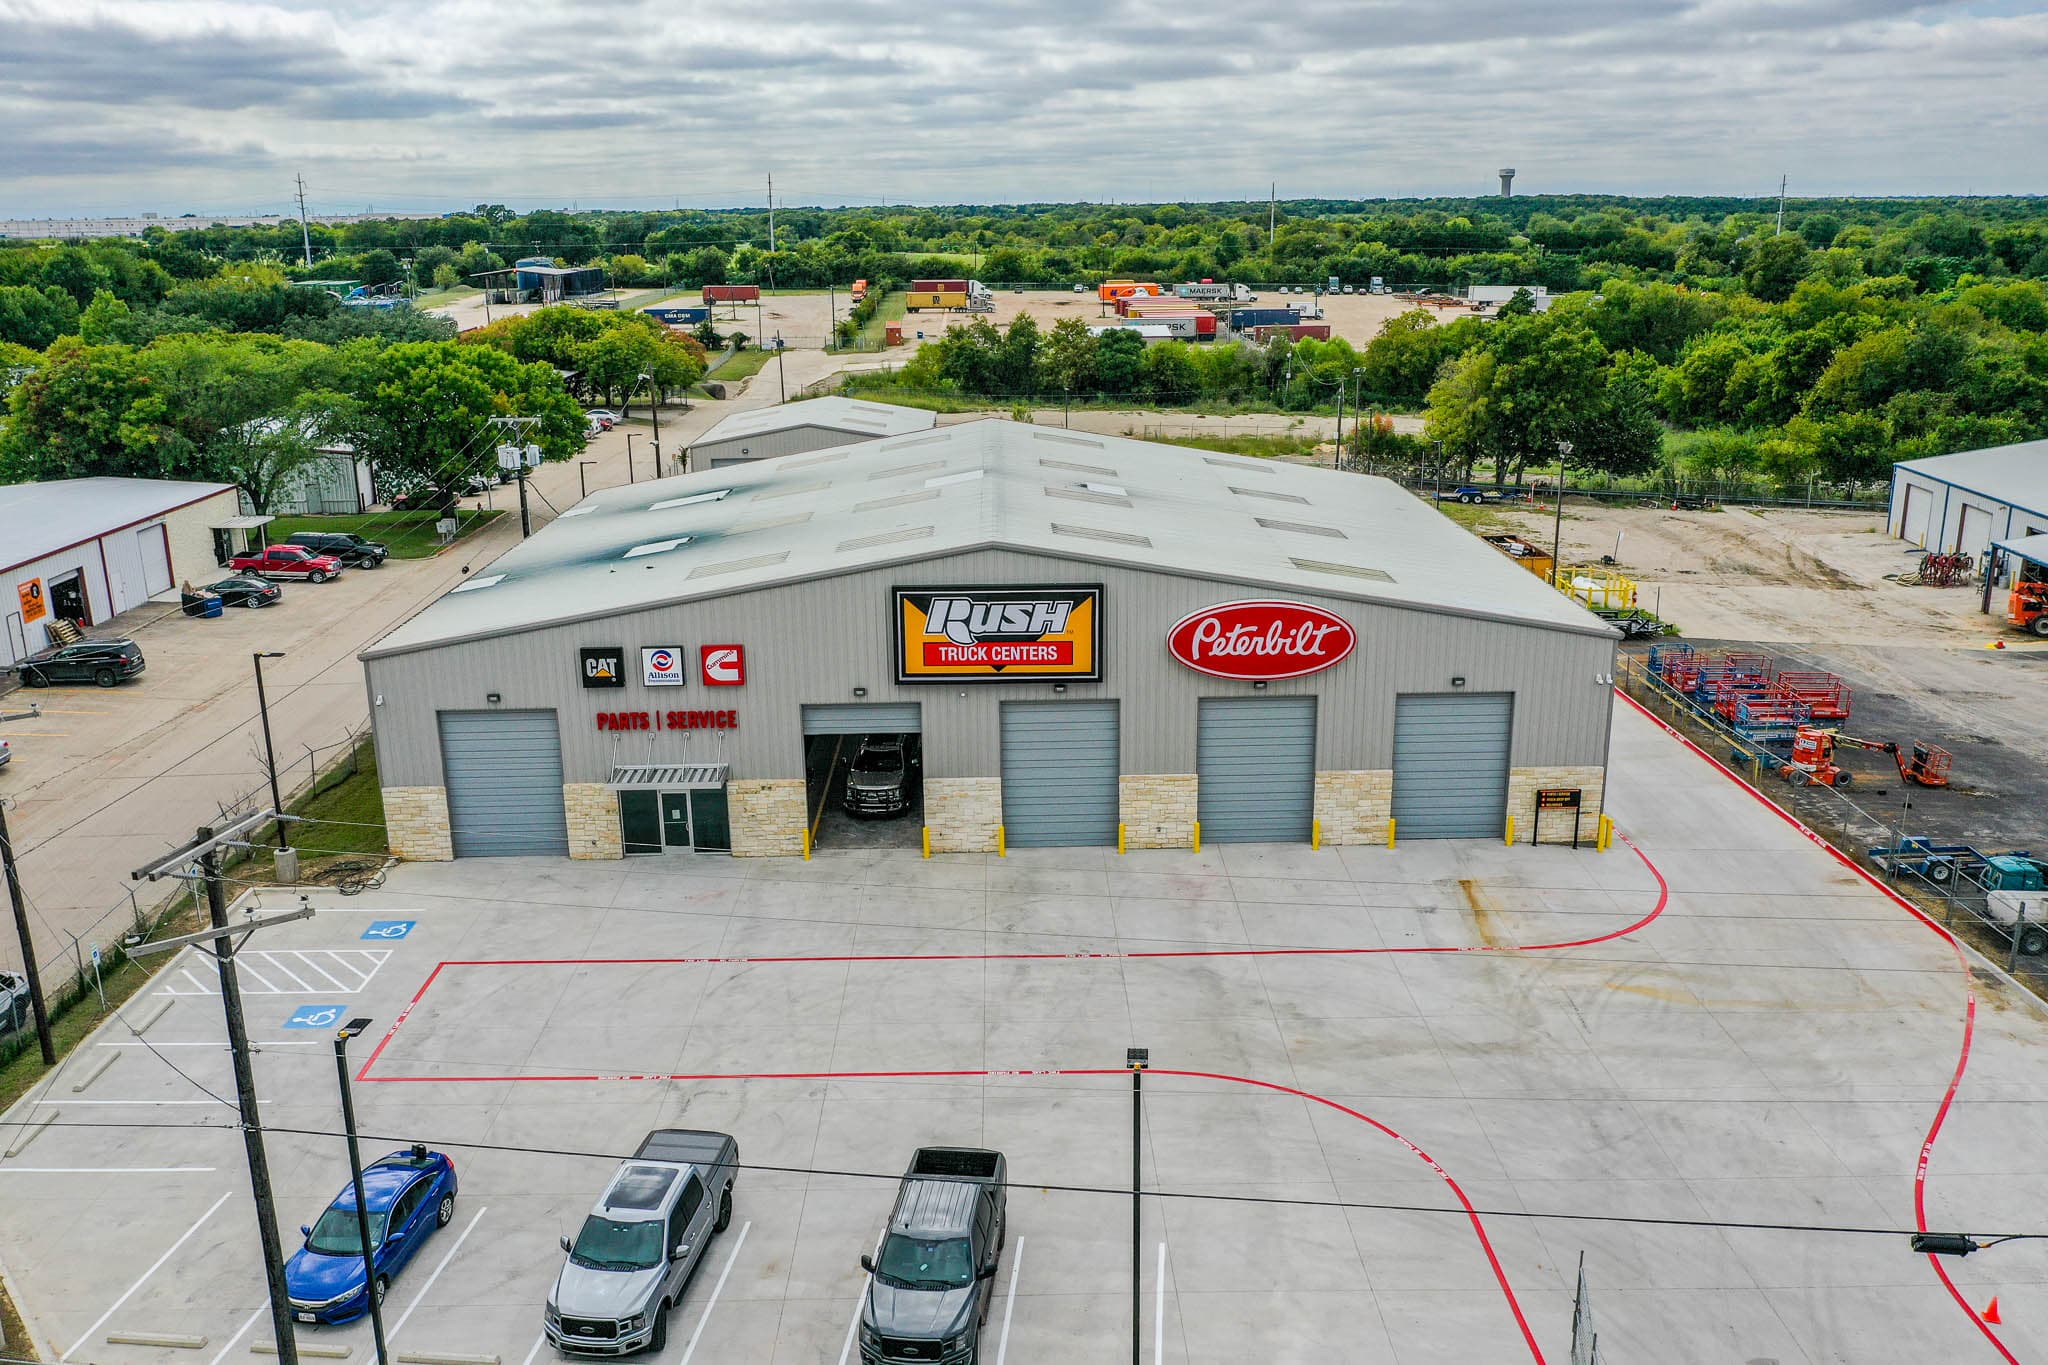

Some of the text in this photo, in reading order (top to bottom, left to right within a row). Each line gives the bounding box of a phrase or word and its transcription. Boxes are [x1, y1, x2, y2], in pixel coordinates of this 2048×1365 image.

[924, 597, 1073, 645] RUSH
[1191, 617, 1341, 661] Peterbilt
[706, 649, 735, 670] Cummins
[939, 645, 1058, 662] TRUCK CENTERS
[585, 658, 618, 678] CAT
[648, 671, 680, 679] Allison
[596, 711, 650, 731] PARTS
[667, 709, 738, 730] SERVICE
